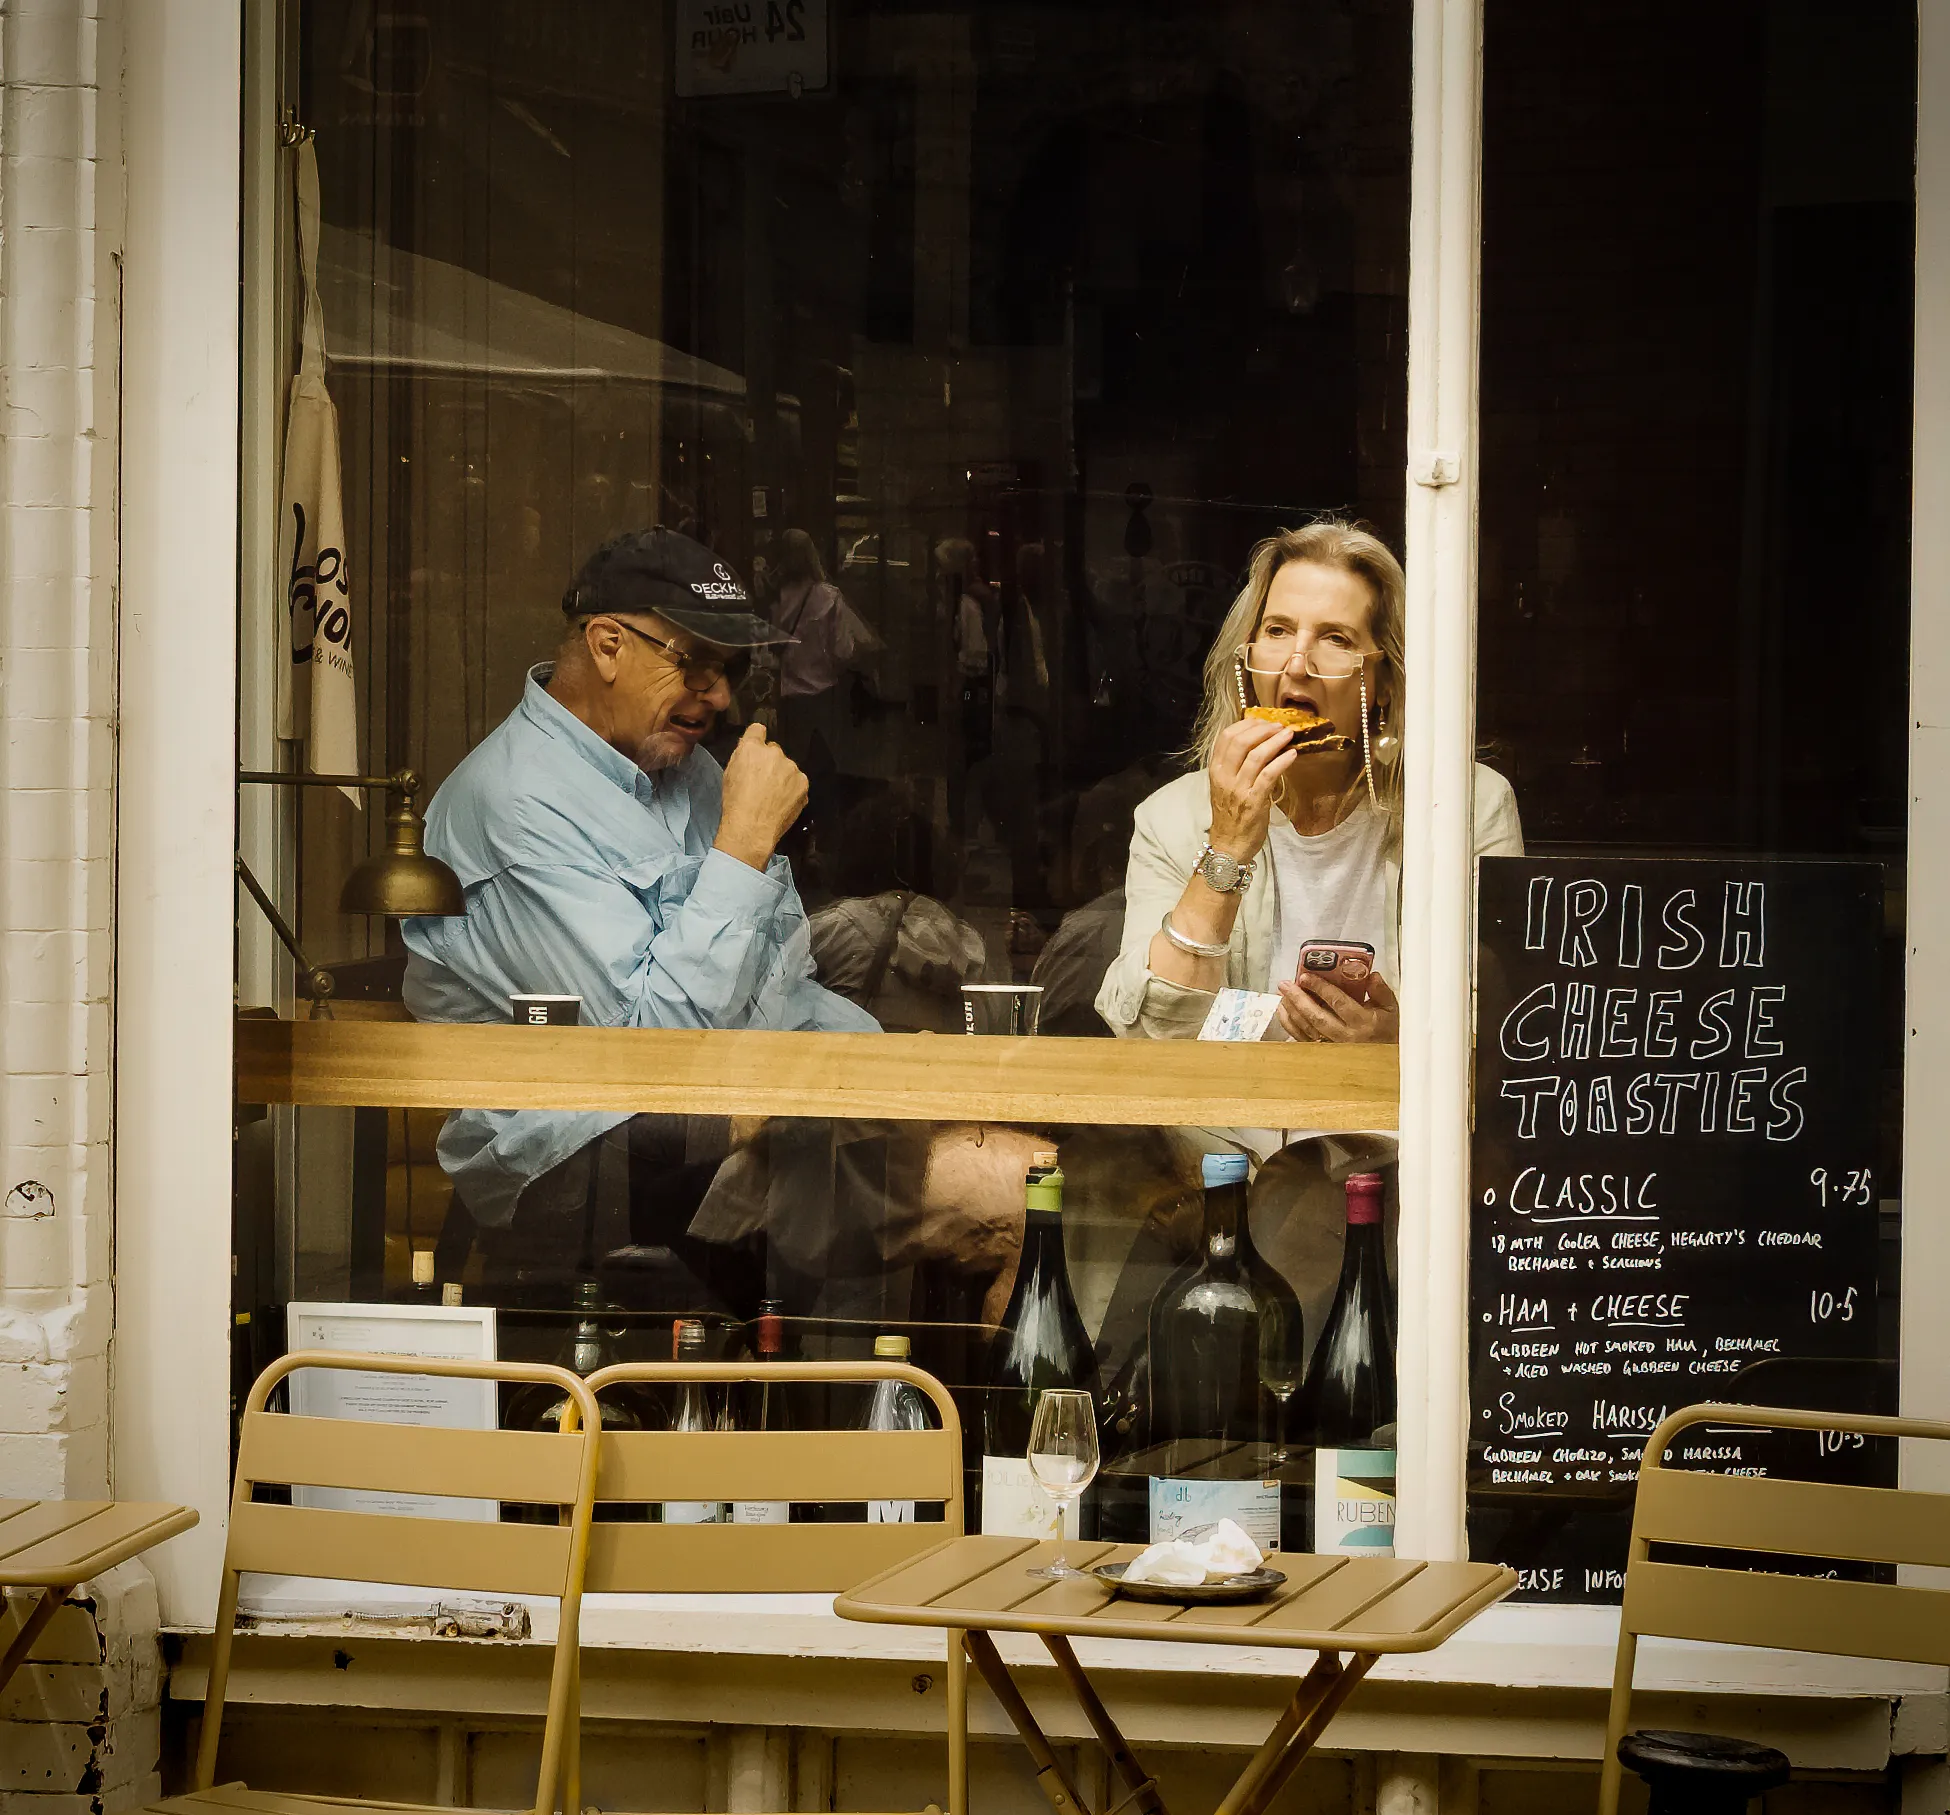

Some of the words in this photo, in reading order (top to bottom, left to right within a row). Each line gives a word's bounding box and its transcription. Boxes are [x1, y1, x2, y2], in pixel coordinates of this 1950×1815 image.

[1525, 876, 1766, 970] IRISH
[1500, 982, 1786, 1062] CHEESE
[1500, 1067, 1807, 1141] TOASTIES
[1509, 1167, 1659, 1214] CLASSIC
[1810, 1167, 1872, 1207] 9.75
[1491, 1234, 1506, 1253] 18
[1611, 1231, 1665, 1255] CHEESE,
[1671, 1229, 1746, 1247] HEGARTY'S
[1757, 1231, 1823, 1249] CHEDDAR
[1508, 1255, 1578, 1272] BECHAMEL
[1498, 1293, 1549, 1326] HAM
[1591, 1294, 1690, 1322] CHEESE
[1575, 1341, 1600, 1356] HOT
[1604, 1340, 1656, 1354] SMOKED
[1715, 1337, 1782, 1353] BECHAMEL
[1514, 1362, 1549, 1379] AGED
[1561, 1362, 1612, 1375] WASHED
[1688, 1359, 1742, 1375] CHEESE
[1499, 1391, 1569, 1435] SMOKED
[1552, 1447, 1614, 1465] CHORIZO,
[1683, 1446, 1742, 1461] HARISSA
[1492, 1468, 1554, 1484] BECHAMEL
